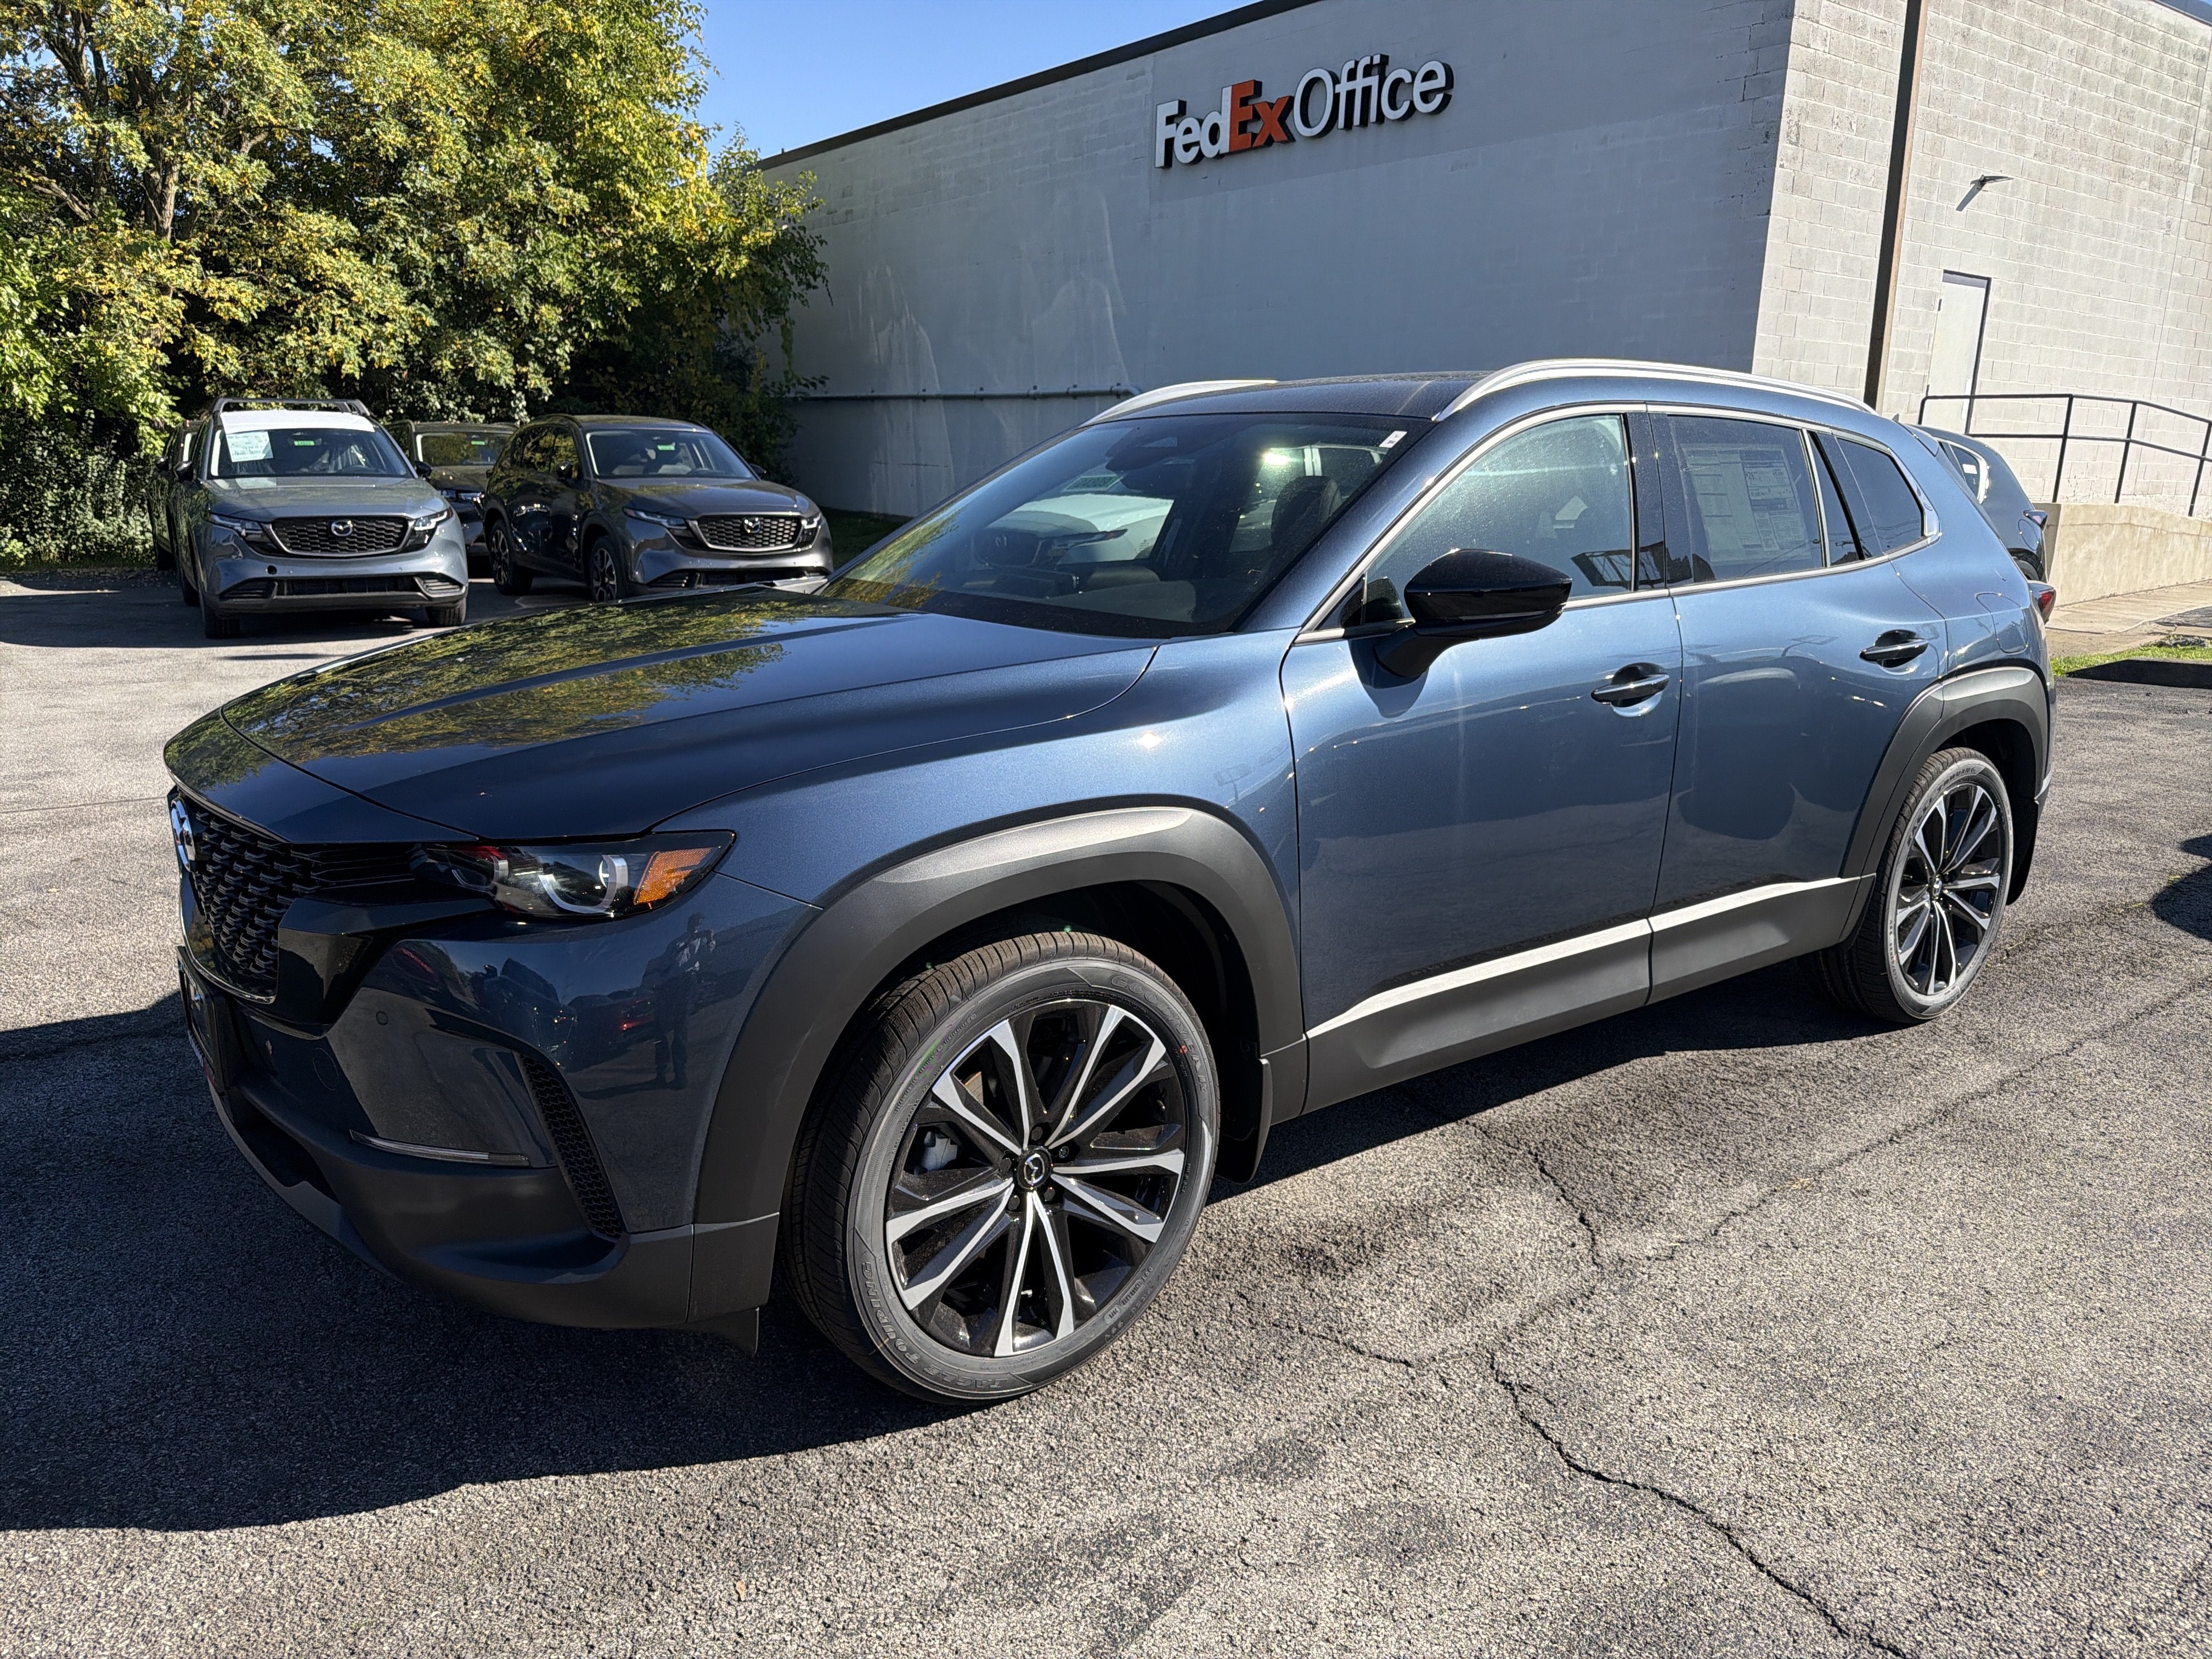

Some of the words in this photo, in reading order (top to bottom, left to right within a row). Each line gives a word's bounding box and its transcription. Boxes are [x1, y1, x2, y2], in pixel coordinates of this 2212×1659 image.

[1155, 80, 1295, 168] FedEx
[1293, 54, 1454, 138] Office
[1110, 974, 1208, 1093] GOODYEAR
[861, 1261, 922, 1365] TOURING
[922, 1364, 1009, 1390] EAGLE
